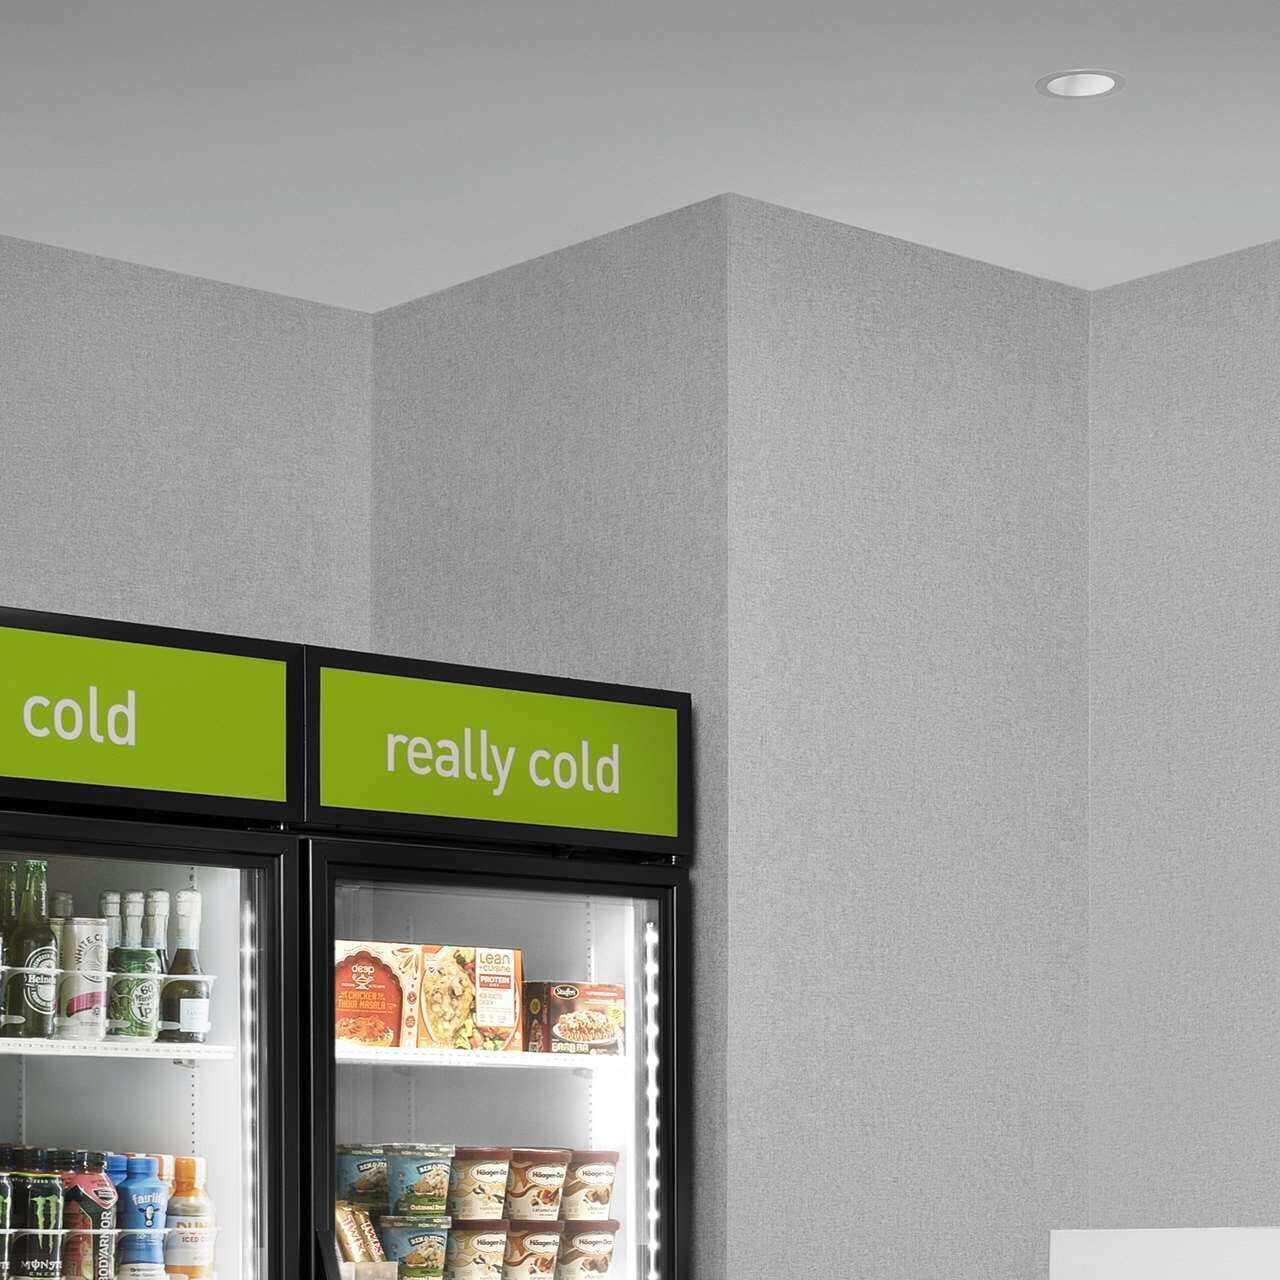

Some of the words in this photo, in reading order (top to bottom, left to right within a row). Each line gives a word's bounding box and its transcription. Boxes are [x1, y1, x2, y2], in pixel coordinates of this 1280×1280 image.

[22, 686, 136, 746] cold
[386, 728, 515, 796] really
[529, 739, 620, 793] cold
[75, 936, 94, 965] WHITE
[480, 953, 511, 965] Lean
